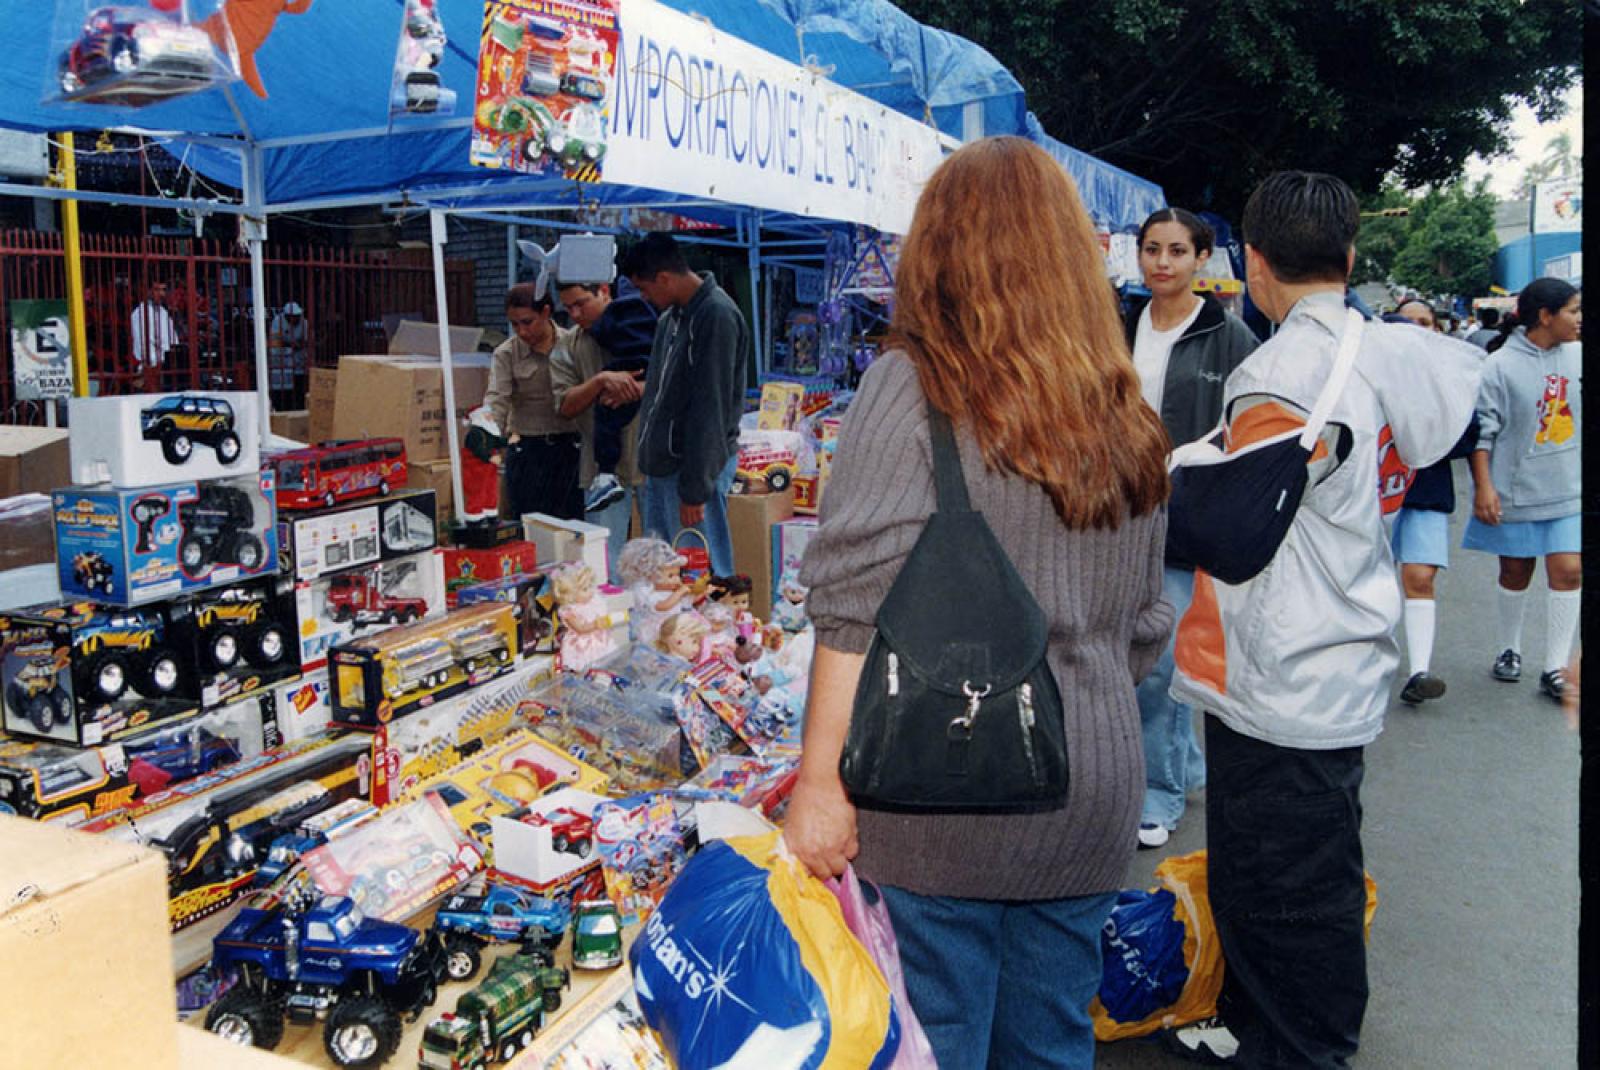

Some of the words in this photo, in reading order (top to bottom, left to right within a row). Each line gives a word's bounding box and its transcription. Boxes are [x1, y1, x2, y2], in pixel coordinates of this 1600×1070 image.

[612, 34, 805, 177] MPORTACIONES
[40, 377, 71, 388] BAZA
[647, 911, 706, 999] orian's
